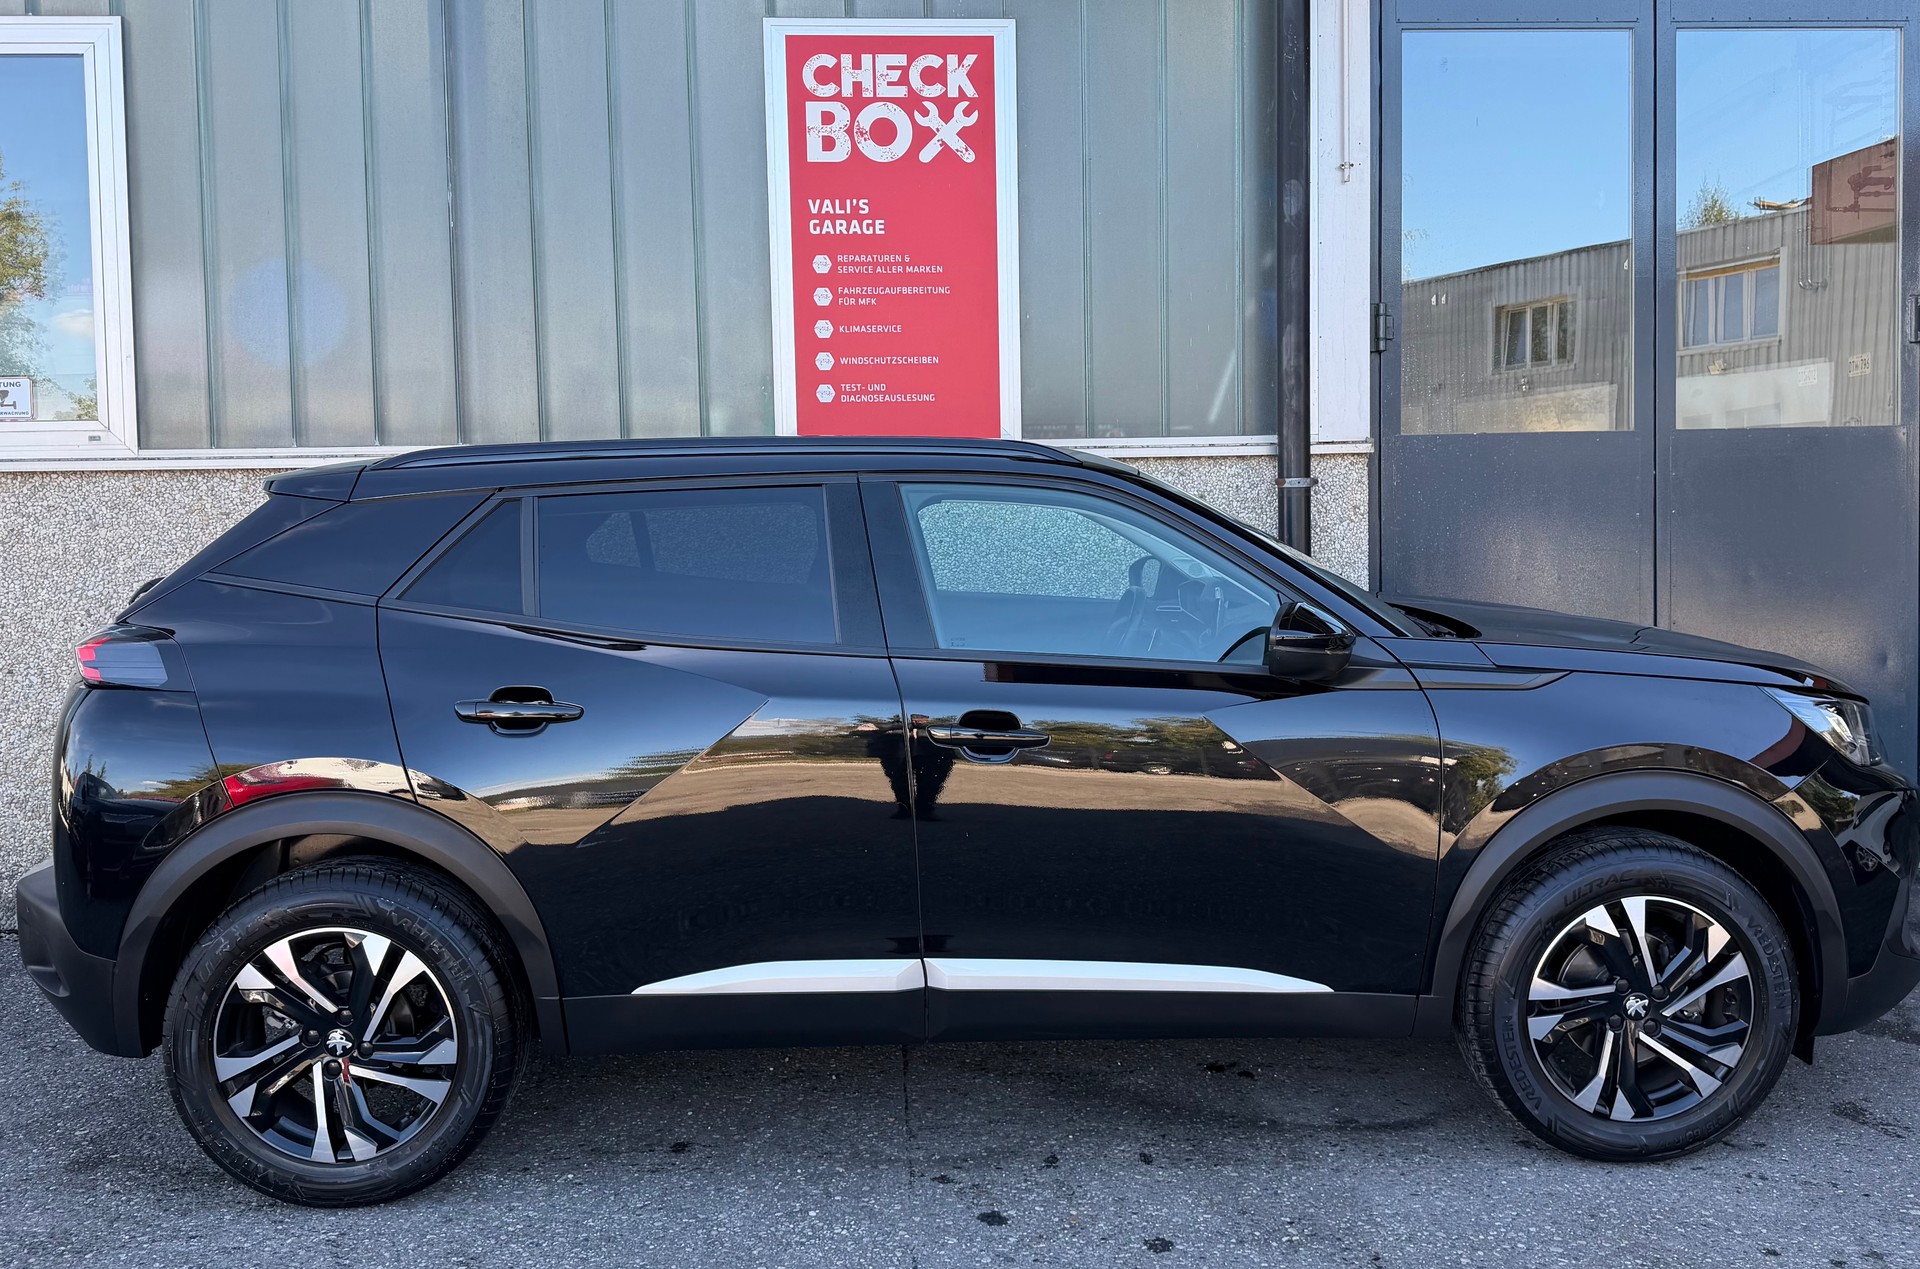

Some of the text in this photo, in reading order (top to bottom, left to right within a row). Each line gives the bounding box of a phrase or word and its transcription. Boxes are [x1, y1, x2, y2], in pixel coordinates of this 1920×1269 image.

[802, 53, 979, 98] CHECK
[807, 198, 870, 215] VALI'S
[809, 219, 885, 235] GARAGE
[837, 254, 911, 263] REPARATUREN &
[837, 265, 943, 274] SERVICE ALLER MARKEN
[838, 286, 951, 295] FAHRZEUGAUFBEREITUNG
[838, 297, 877, 306] FÜR MFK
[839, 324, 902, 333] KLIMASERVICE
[839, 356, 939, 365] WINDSCHUTZSCHEIBEN
[840, 383, 887, 392] TEST- UND
[840, 393, 936, 403] DIAGNOSEAUSLESUNG
